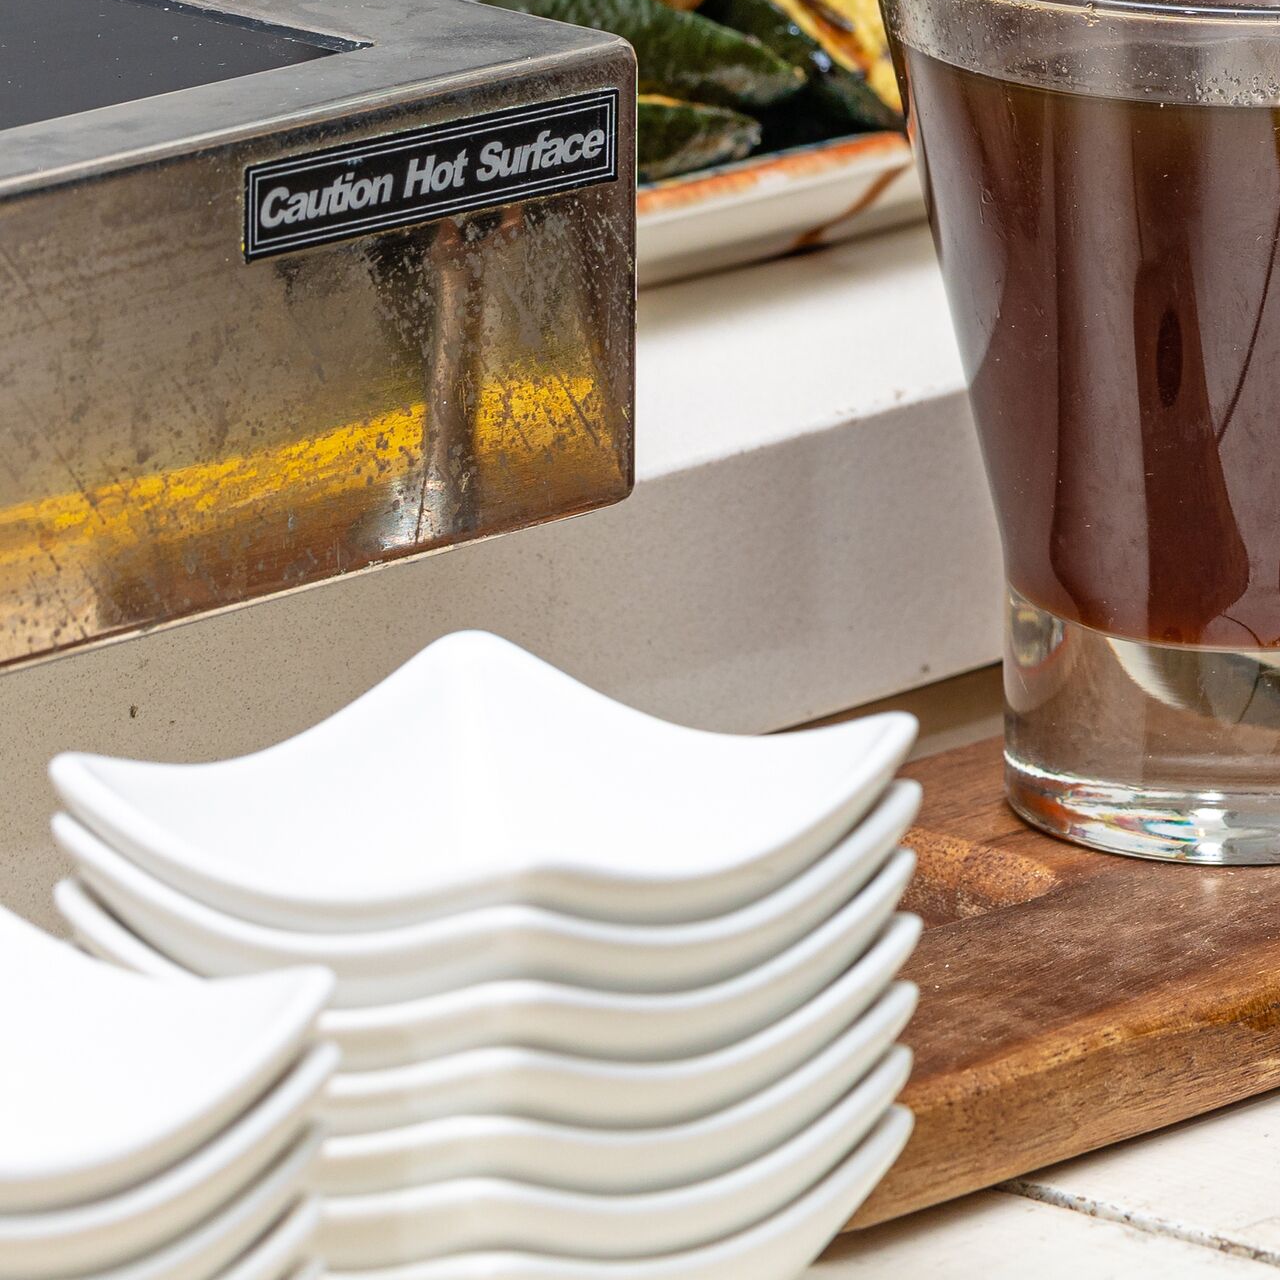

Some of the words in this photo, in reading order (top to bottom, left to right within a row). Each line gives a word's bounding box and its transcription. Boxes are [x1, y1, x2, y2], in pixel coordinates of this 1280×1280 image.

[260, 170, 394, 229] Caution
[403, 148, 469, 199] Hot
[476, 128, 605, 182] Surface
